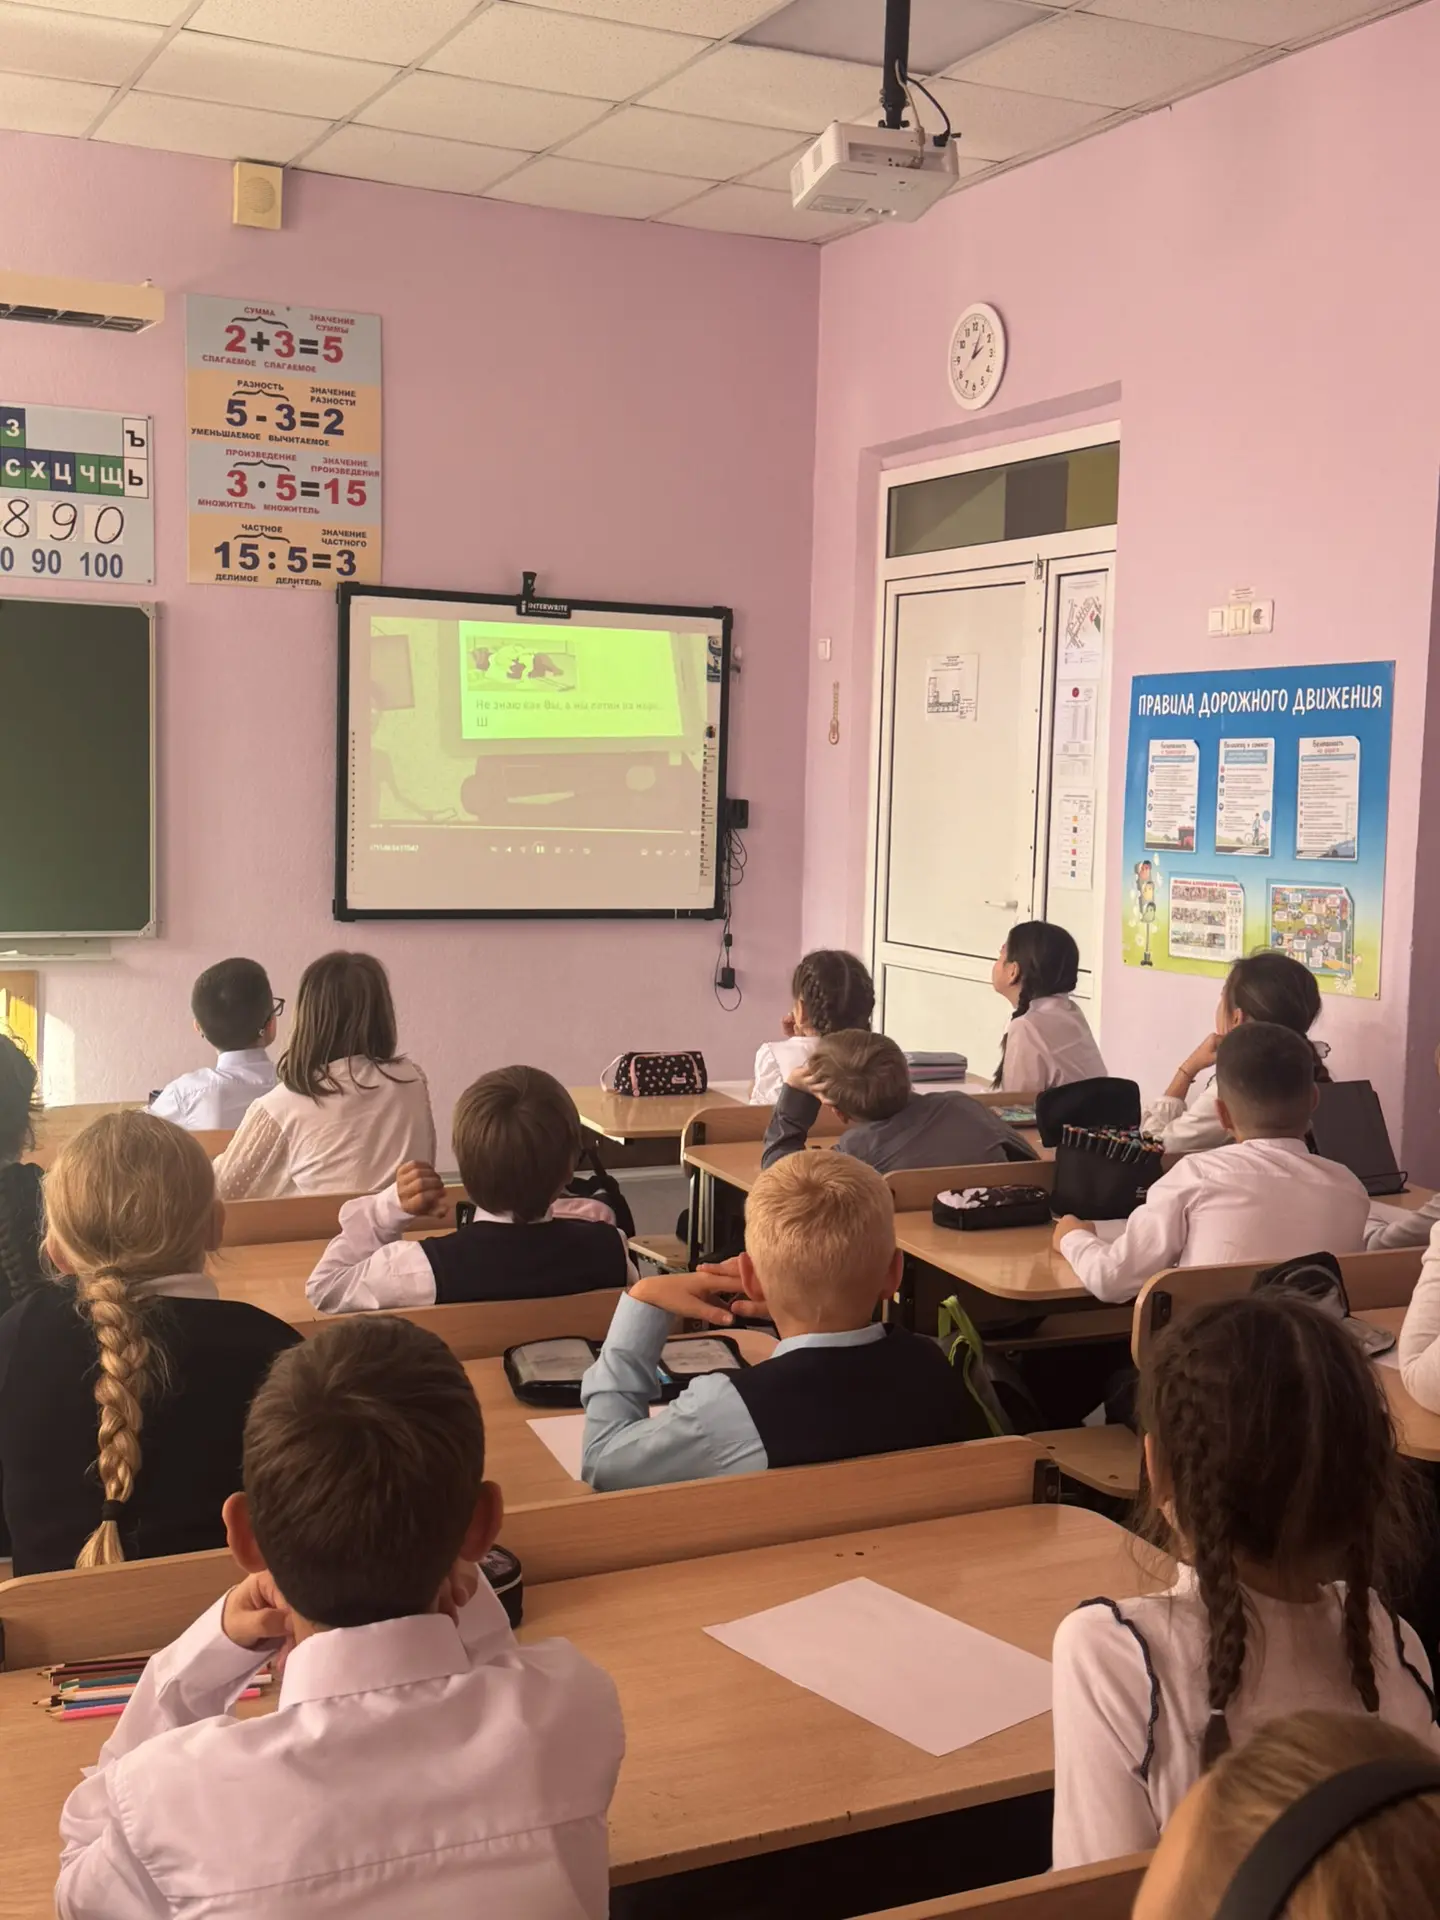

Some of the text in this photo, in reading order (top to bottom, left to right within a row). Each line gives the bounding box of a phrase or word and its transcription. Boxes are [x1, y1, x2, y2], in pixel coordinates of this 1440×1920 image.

[244, 306, 275, 317] СУММА
[309, 313, 356, 326] ЗНАЧЕНИЕ
[315, 324, 350, 334] СУММЫ
[202, 354, 317, 373] СЛАГАЕМОЕ СЛАГАЕМОЕ
[236, 379, 285, 391] РАЗНОСТЬ
[309, 386, 356, 398] ЗНАЧЕНИЕ
[310, 396, 356, 407] РАЗНОСТИ
[191, 427, 330, 447] УМЕНЬШАЕМОЕ ВЫЧИТАЕМОЕ
[225, 448, 297, 462] ПРОИЗВЕДЕНИЕ
[322, 456, 368, 468] ЗНАЧЕНИЕ
[310, 465, 380, 478] ПРОИЗВЕДЕНИЯ
[198, 498, 320, 515] МНОЖИТЕЛЬ МНОЖИТЕЛЬ
[3, 499, 124, 544] 8 9 0
[241, 523, 283, 534] ЧАСТНОЕ
[321, 528, 368, 539] ЗНАЧЕНИЕ
[321, 537, 368, 548] ЧАСТНОГО
[31, 548, 62, 575] 90
[79, 551, 124, 579] 100
[215, 573, 322, 587] ДЕЛИМОЕ ДЕЛИТЕЛЬ
[528, 602, 568, 612] INTERWRITE
[1138, 684, 1383, 718] ПРАВИЛА ДОРОЖНОГО ДВИЖЕНИЯ
